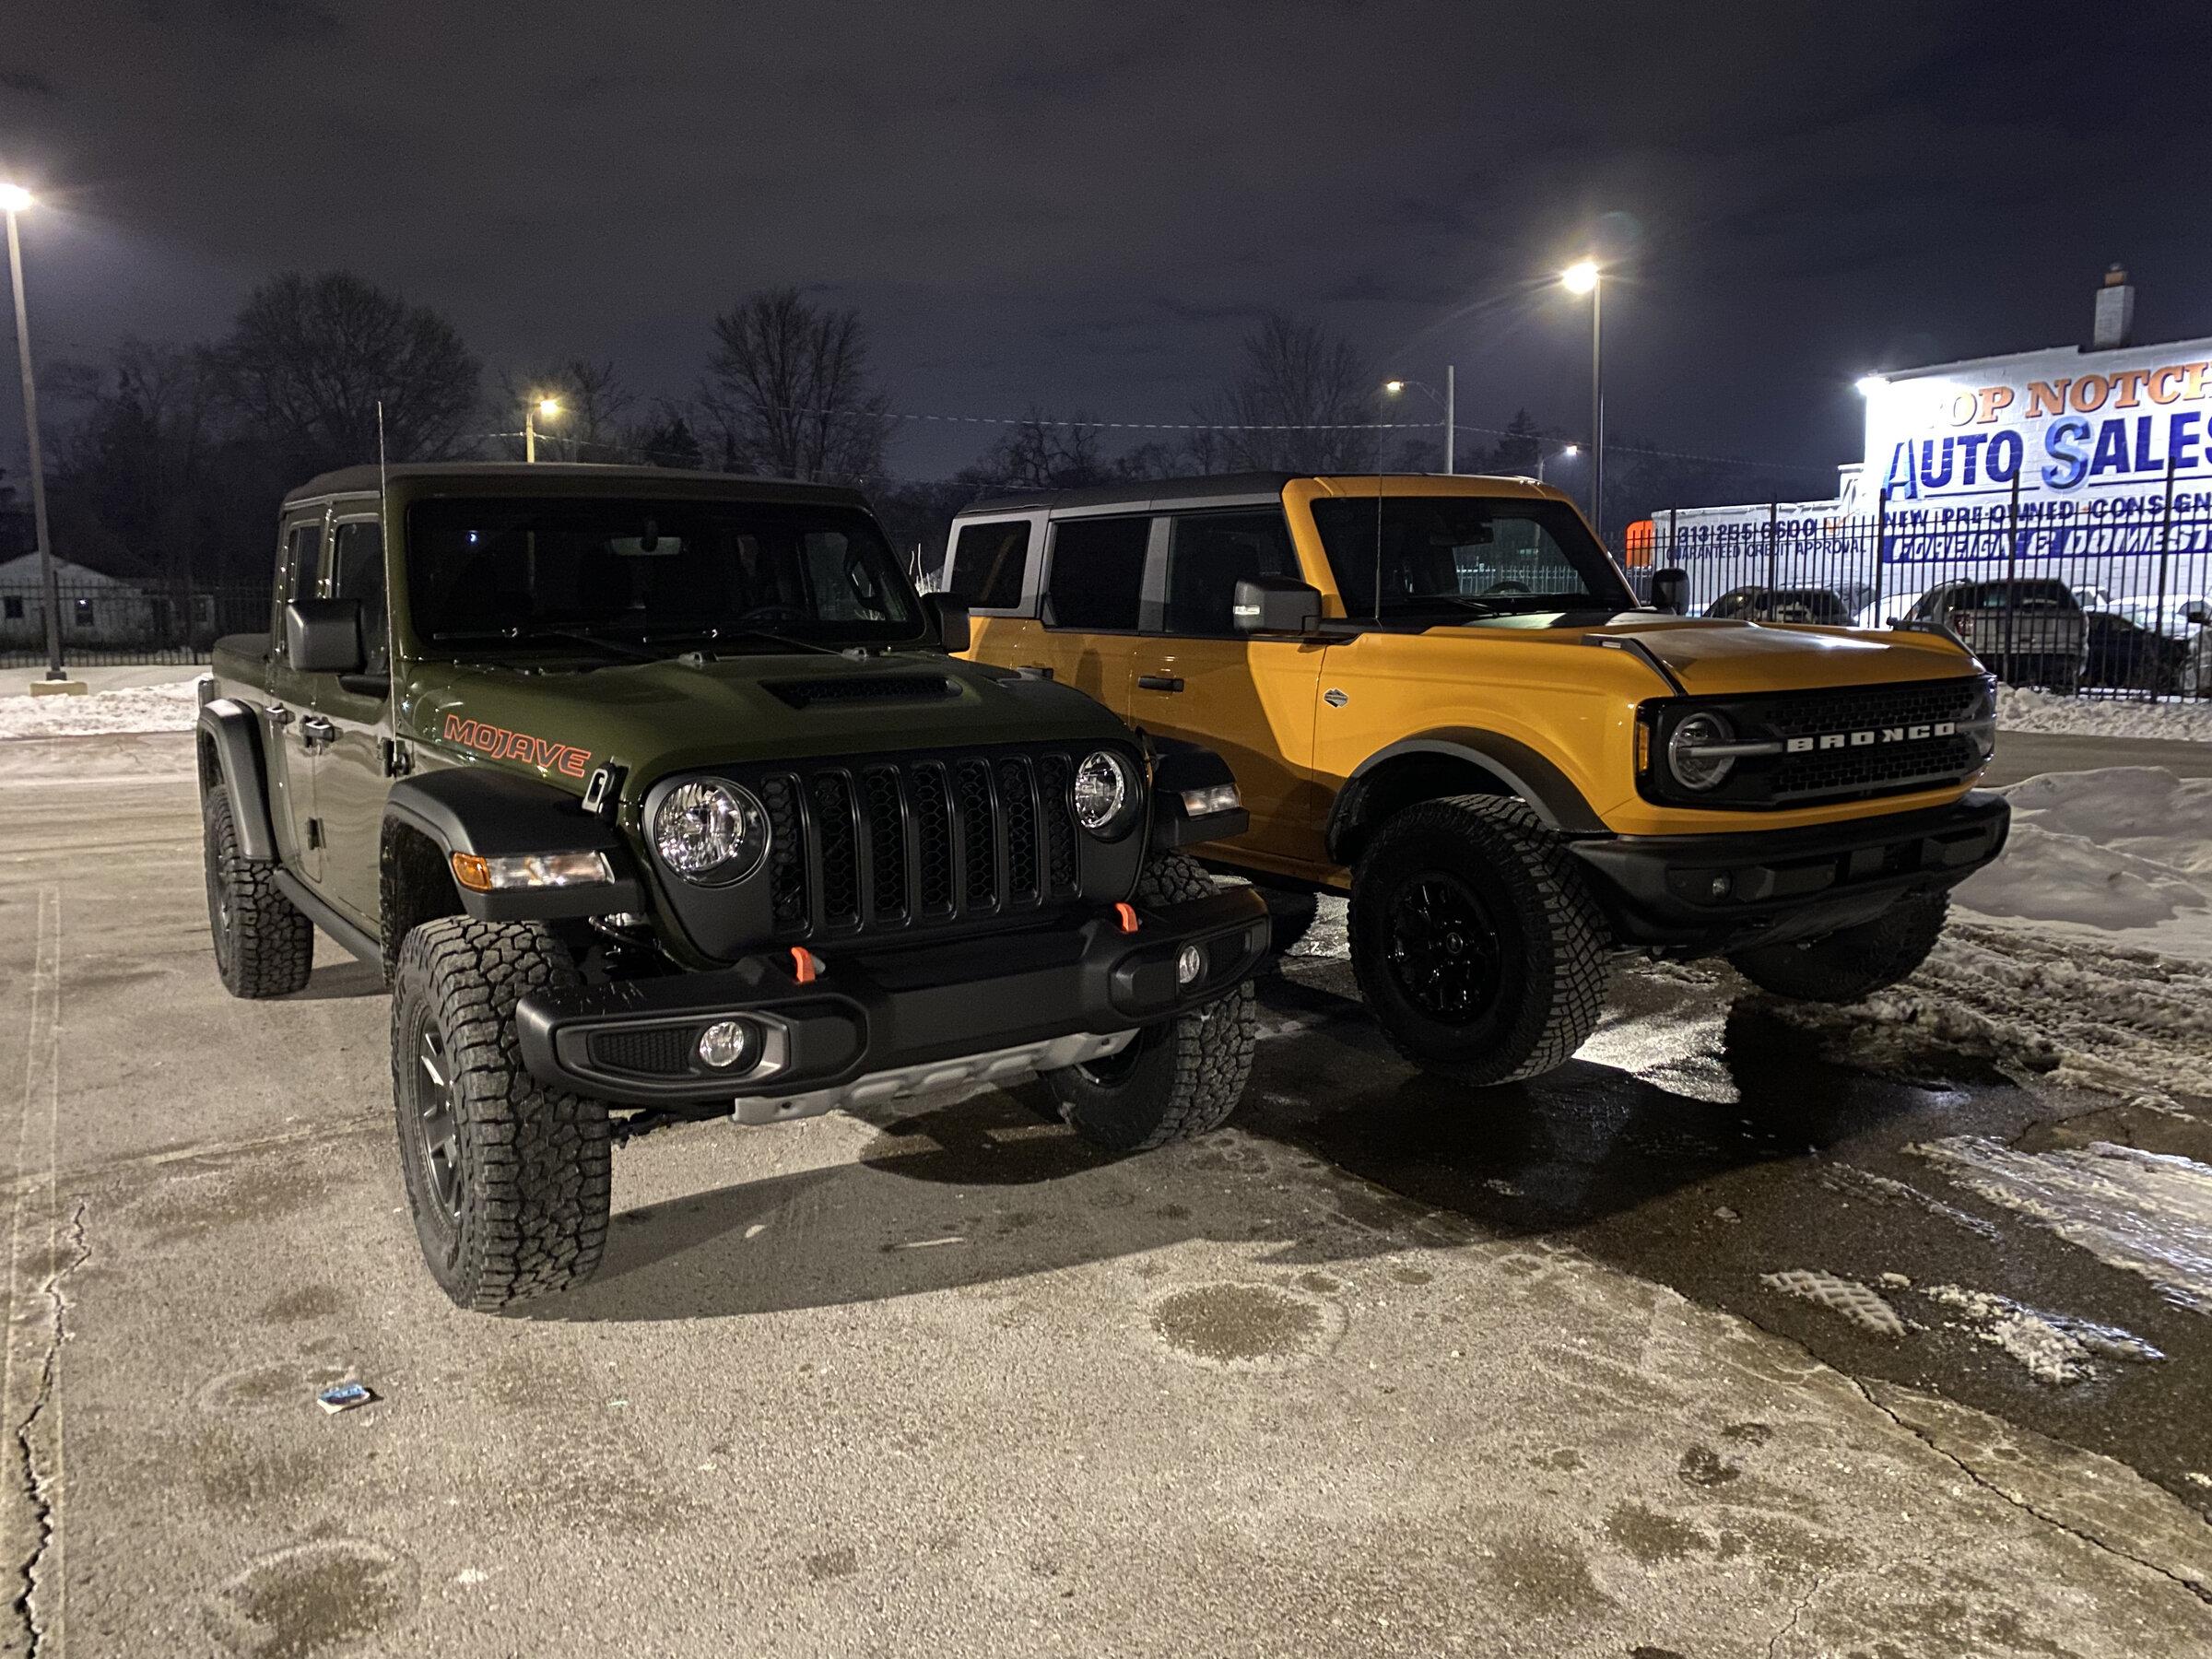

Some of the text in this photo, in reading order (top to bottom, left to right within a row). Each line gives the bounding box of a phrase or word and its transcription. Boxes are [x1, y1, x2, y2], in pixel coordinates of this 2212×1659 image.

[1926, 385, 2016, 430] OP
[1882, 411, 2212, 500] AUTO SALE
[1884, 509, 1929, 529] NEW
[2092, 492, 2212, 519] CONSGN
[444, 714, 592, 778] MOJAVE
[1787, 723, 1956, 753] BRONCO
